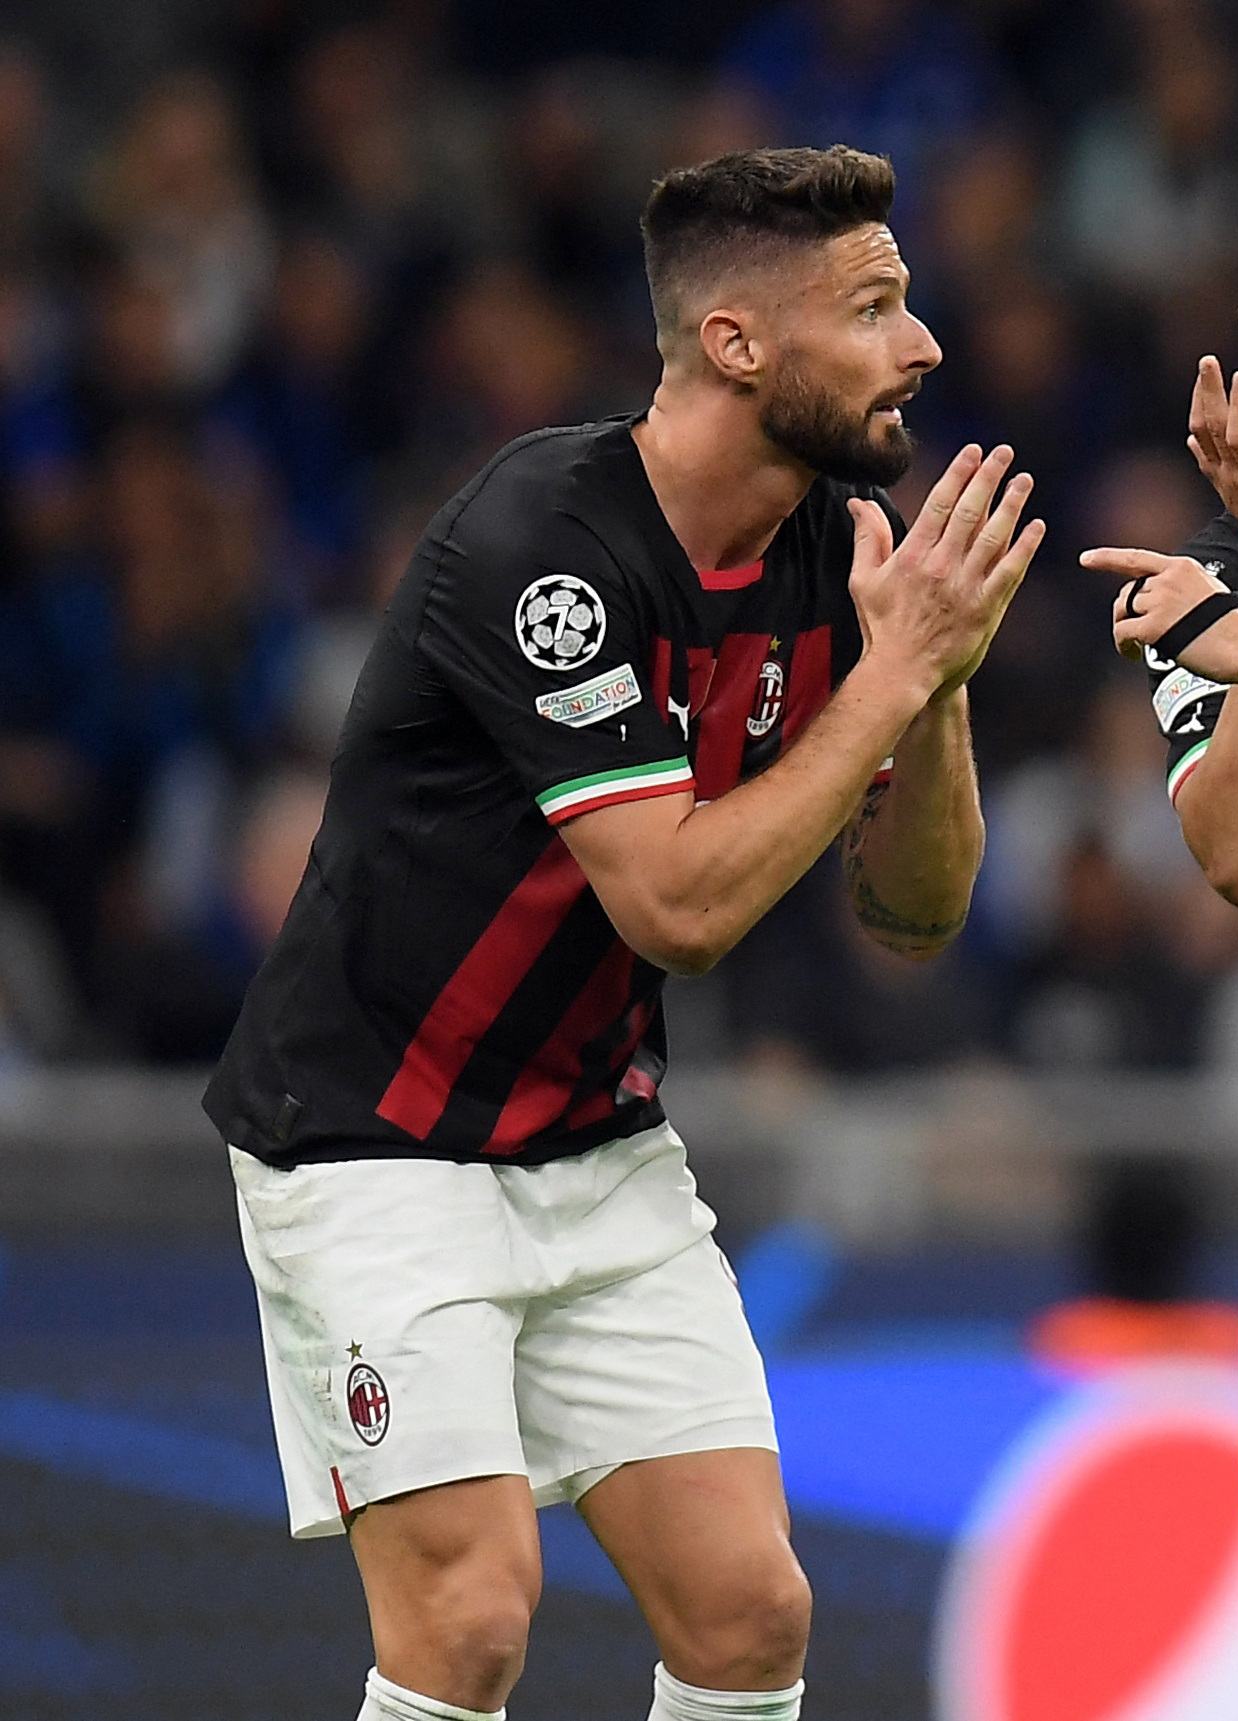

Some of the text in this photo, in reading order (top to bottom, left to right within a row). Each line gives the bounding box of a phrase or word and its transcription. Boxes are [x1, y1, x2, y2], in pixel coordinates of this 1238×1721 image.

[547, 605, 567, 639] 7
[541, 677, 635, 719] FOUNDATION
[363, 1426, 382, 1437] 1899
